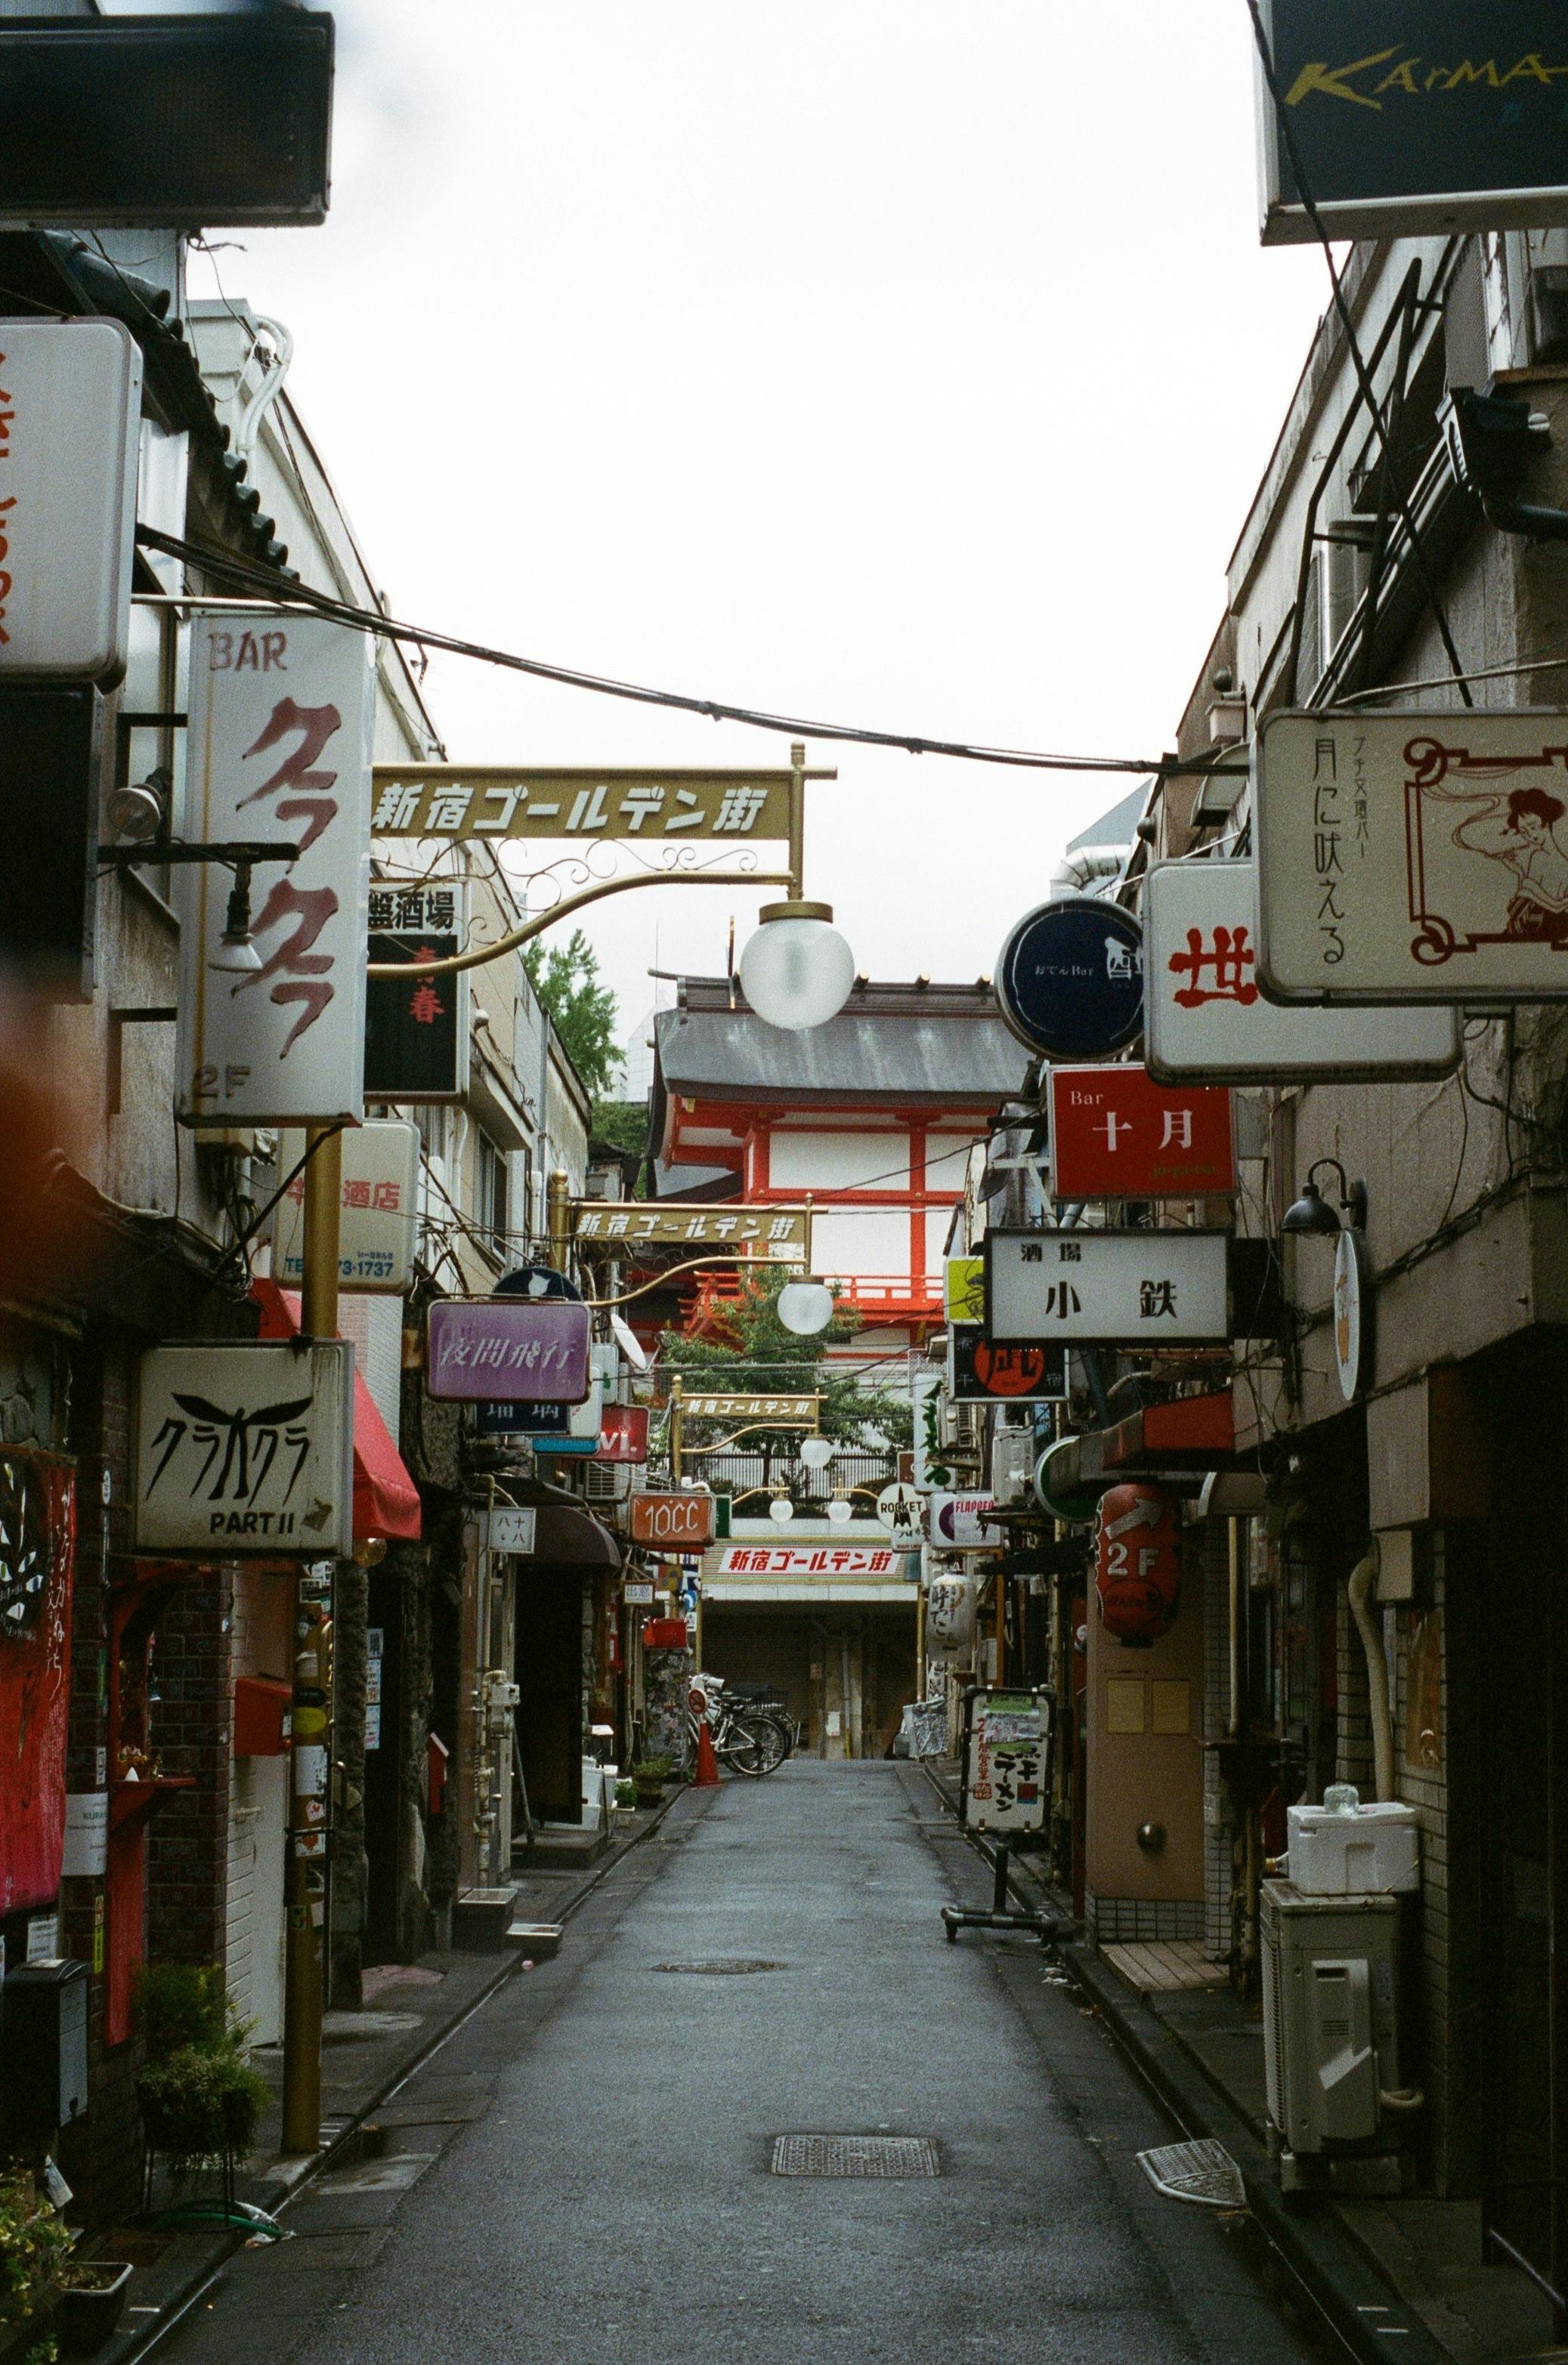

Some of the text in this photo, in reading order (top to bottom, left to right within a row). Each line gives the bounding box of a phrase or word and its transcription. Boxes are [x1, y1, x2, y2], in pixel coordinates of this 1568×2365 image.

[208, 632, 288, 672] BAR
[370, 782, 769, 832] 新宿ゴールデン街
[1313, 737, 1346, 965] 月に吠える
[231, 696, 342, 1060] クラクラ
[1072, 963, 1095, 976] Bar
[192, 1064, 251, 1100] 2F
[1070, 1091, 1103, 1105] Bar
[1093, 1108, 1193, 1152] 十月
[575, 1212, 796, 1240] 新宿ゴールデン街
[1021, 1243, 1082, 1263] 酒場
[1044, 1280, 1177, 1320] 小鉄
[438, 1337, 574, 1370] 夜間飛行
[688, 1399, 810, 1415] 新宿ゴールデン街
[209, 1512, 295, 1535] PART II
[880, 1501, 923, 1514] ROCKET
[728, 1550, 893, 1572] 新宿ゴールデン街
[1107, 1542, 1159, 1577] 2F
[994, 1751, 1016, 1813] ラーメン
